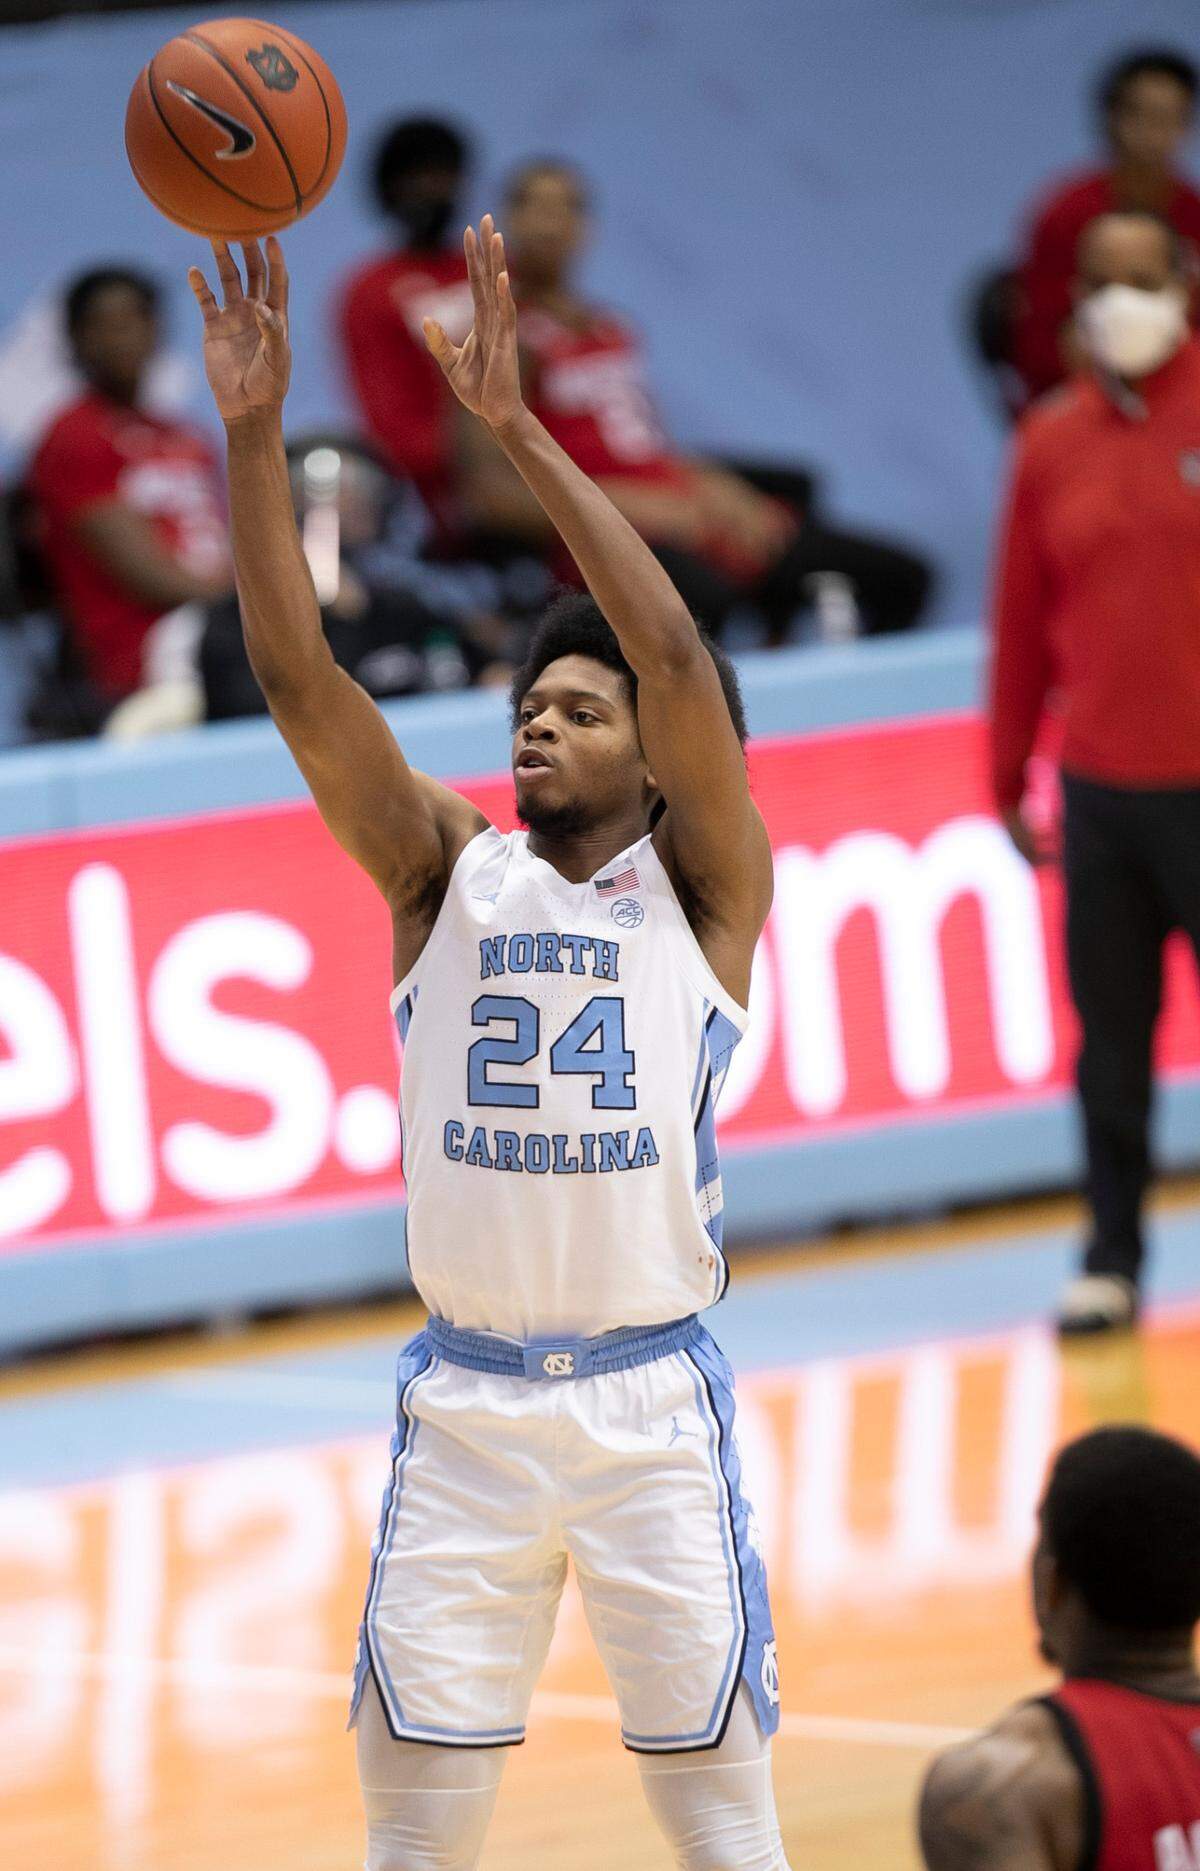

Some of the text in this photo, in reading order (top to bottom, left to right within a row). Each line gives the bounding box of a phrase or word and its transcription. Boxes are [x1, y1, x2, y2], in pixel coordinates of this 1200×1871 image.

[615, 906, 641, 917] ACC
[479, 933, 619, 982] NORTH
[467, 994, 637, 1110] 24
[443, 1119, 660, 1174] CAROLINA
